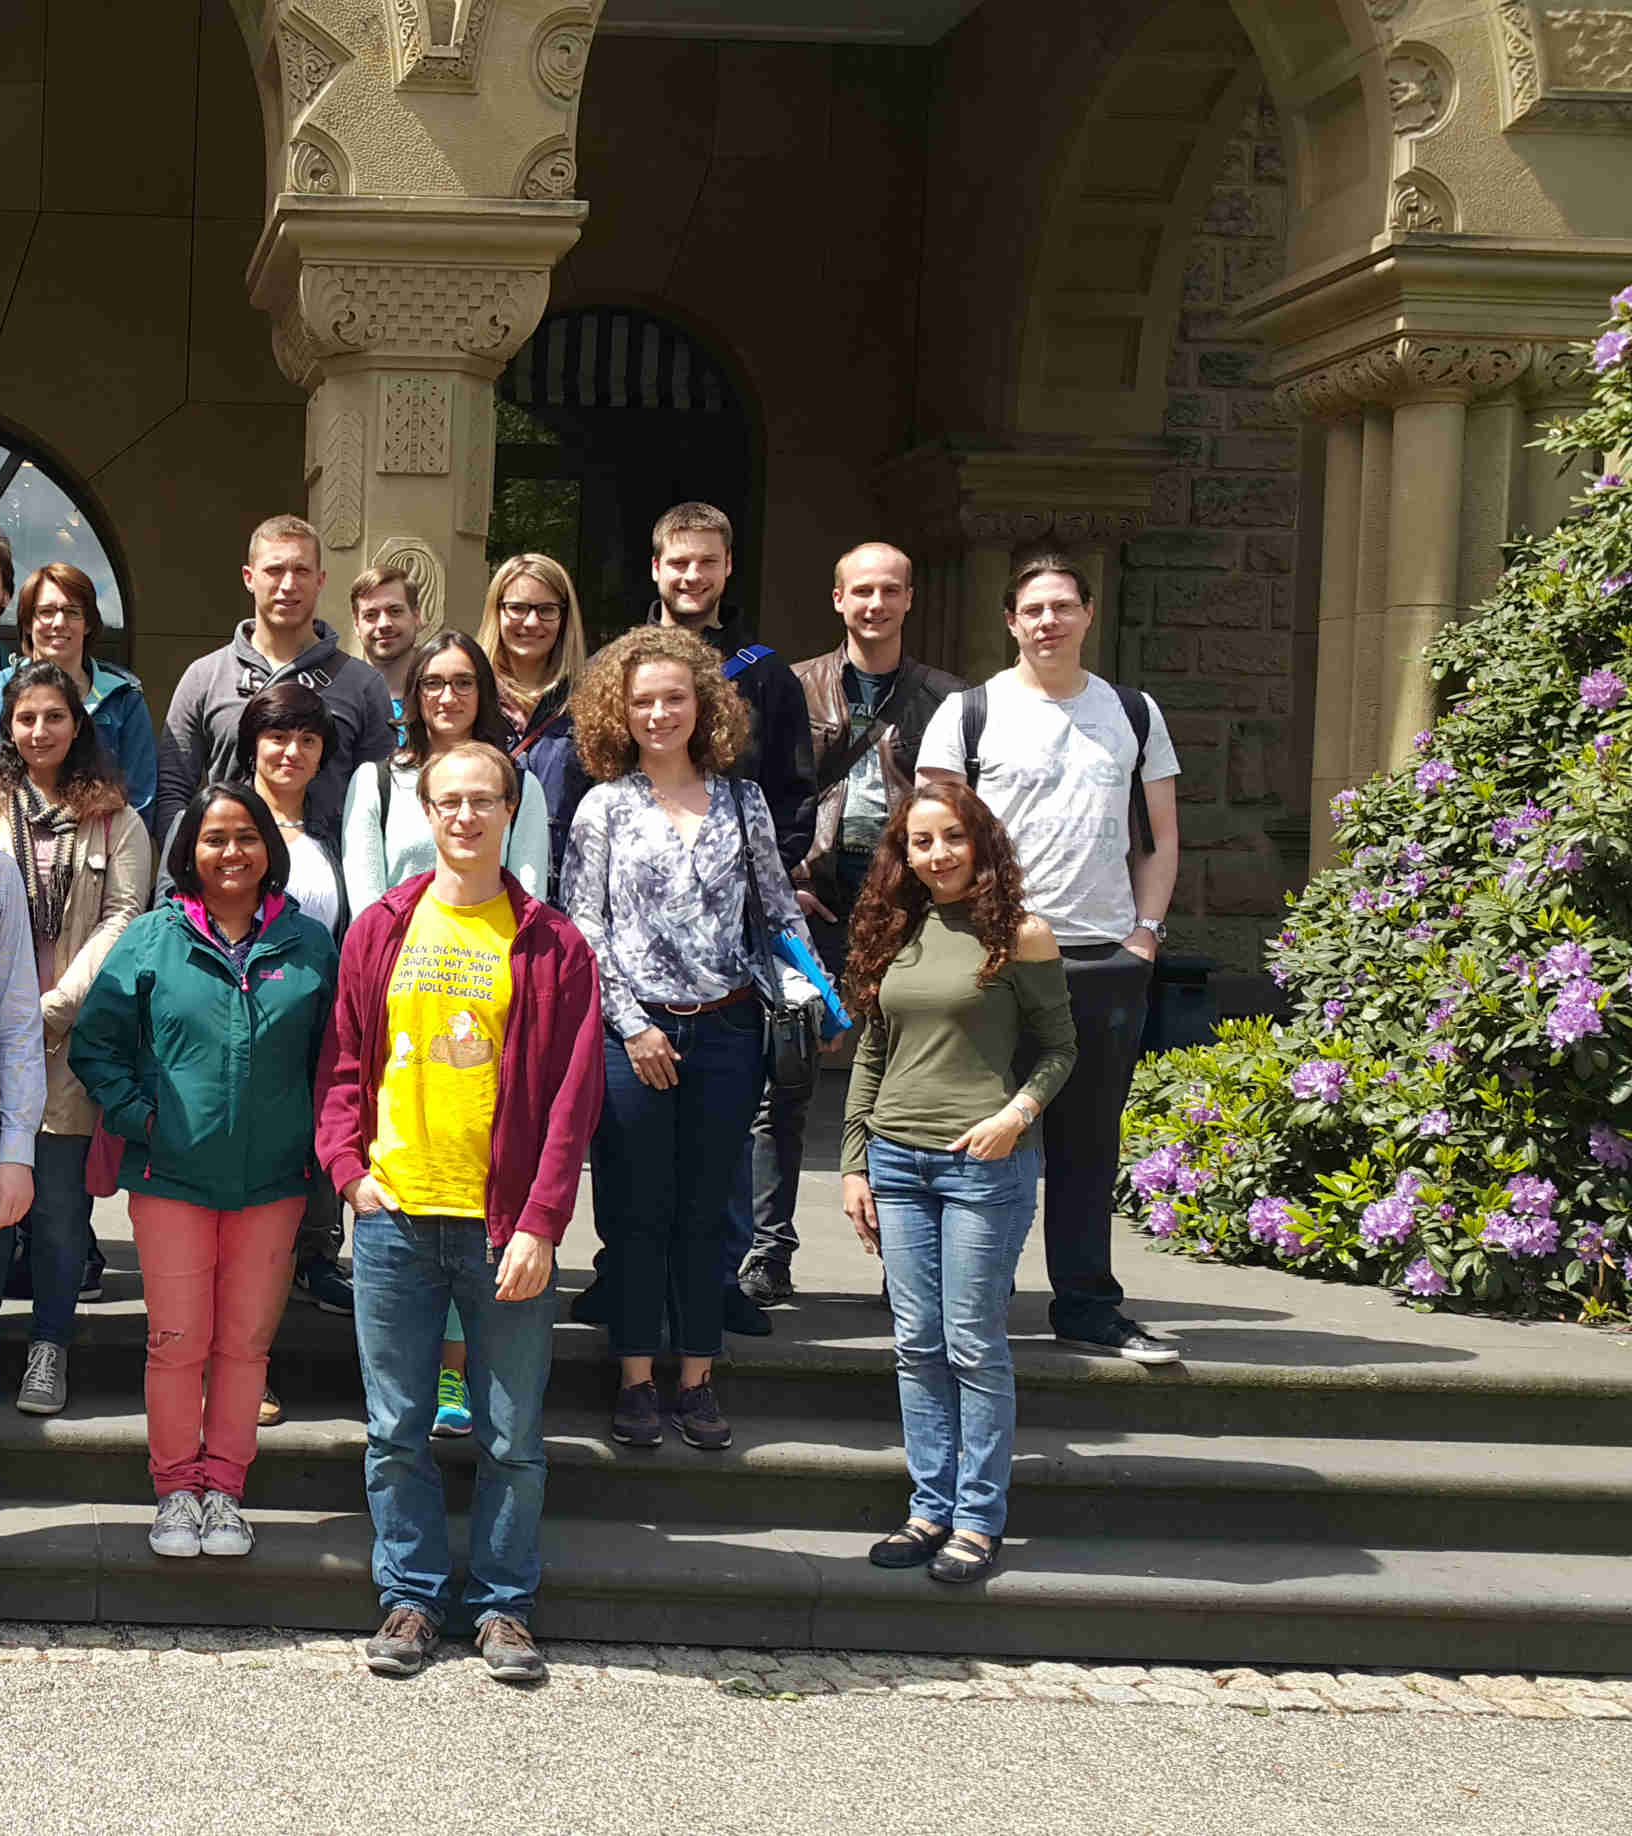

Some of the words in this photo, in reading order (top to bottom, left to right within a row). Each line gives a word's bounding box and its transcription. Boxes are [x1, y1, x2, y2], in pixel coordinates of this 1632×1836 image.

[472, 975, 493, 986] TAG
[392, 982, 414, 993] OFT
[418, 982, 443, 993] VOLL
